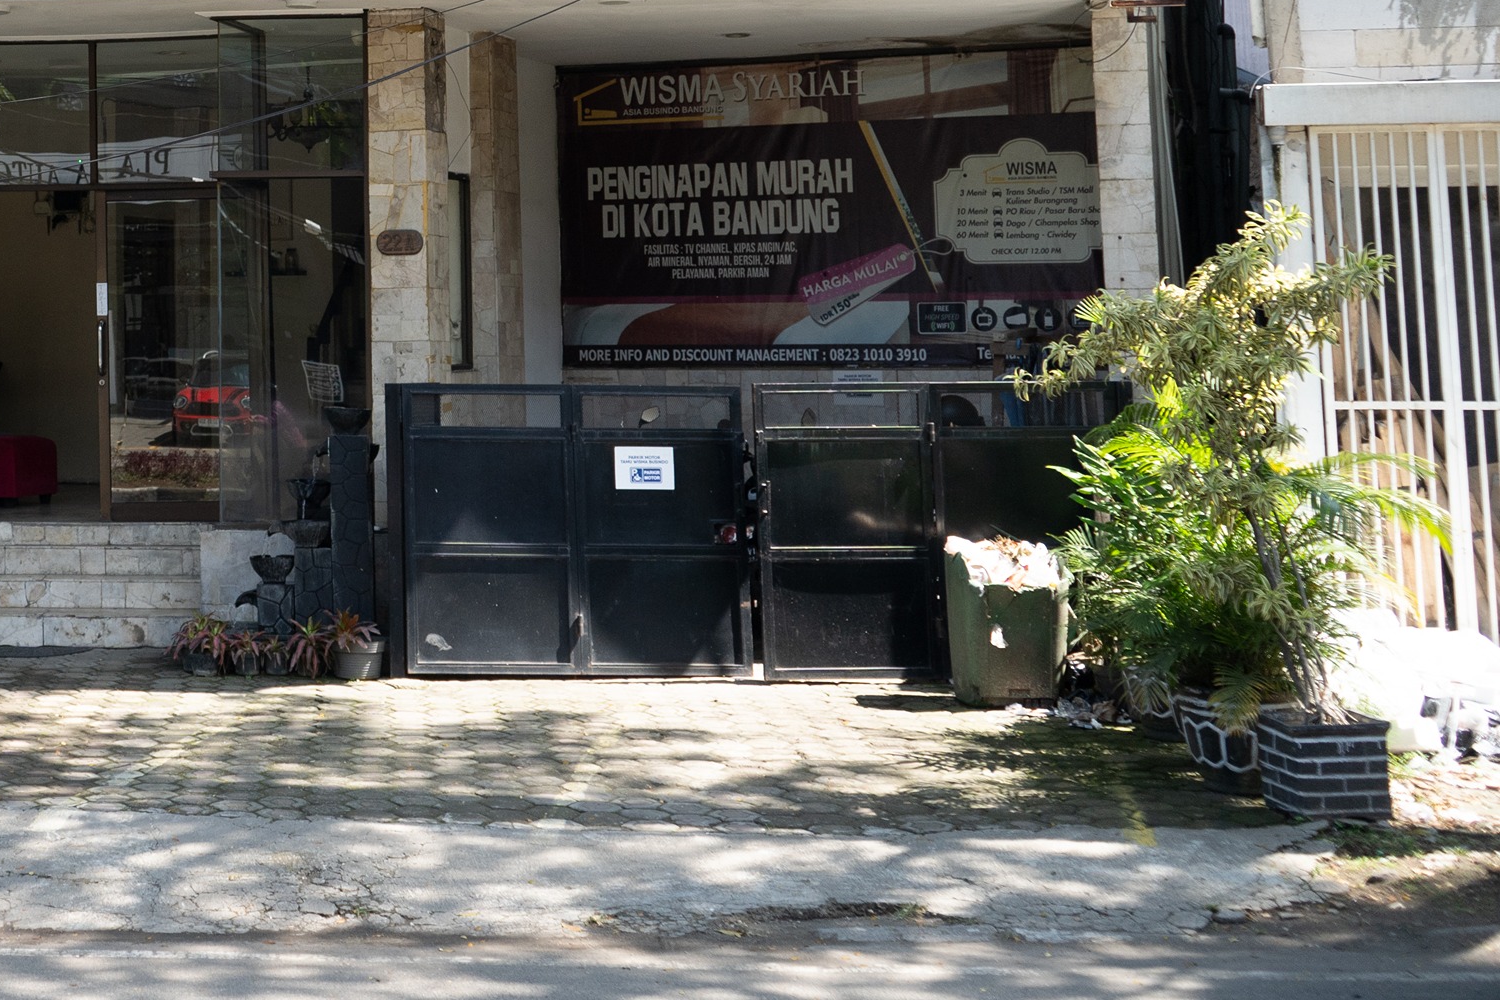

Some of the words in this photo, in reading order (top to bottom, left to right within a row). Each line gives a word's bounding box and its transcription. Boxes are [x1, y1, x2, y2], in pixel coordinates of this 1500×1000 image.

[620, 74, 724, 105] WISMA
[732, 70, 867, 102] SYARIAH
[622, 108, 644, 116] ASIA
[645, 106, 679, 116] BUSINDO
[682, 105, 724, 114] BANDUNG
[1006, 161, 1057, 175] WISMA
[587, 161, 749, 200] PENGINAPAN
[756, 158, 854, 196] MURAH
[960, 189, 965, 197] 3
[966, 189, 987, 197] Menit
[1027, 187, 1050, 195] Studio
[1059, 187, 1075, 195] TSM
[1077, 186, 1094, 194] Mall
[1006, 197, 1033, 205] Kuliner
[1034, 197, 1078, 206] Burangrang
[968, 207, 988, 215] Menit
[1019, 207, 1036, 215] Riau
[1045, 207, 1065, 215] Pasar
[1068, 206, 1086, 214] Baru
[602, 203, 626, 239] DI
[633, 202, 705, 238] KOTA
[713, 198, 840, 237] BANDUNG
[957, 219, 967, 227] 20
[968, 219, 989, 227] Menit
[1006, 219, 1026, 228] Dago
[1035, 218, 1078, 228] Cihampelas
[957, 231, 967, 239] 60
[968, 231, 989, 239] Menit
[1006, 231, 1040, 240] Lembang
[1047, 231, 1077, 240] Ciwidey
[684, 244, 695, 255] TV
[695, 243, 732, 255] CHANNEL,
[734, 243, 756, 254] KIPAS
[757, 242, 798, 254] ANGIN/AC,
[1031, 247, 1049, 255] 12.00
[648, 256, 661, 268] AIR
[662, 256, 697, 268] MINERAL,
[698, 255, 732, 267] NYAMAN,
[734, 255, 763, 267] BERSIH,
[765, 255, 774, 266] 24
[775, 254, 792, 266] JAM
[671, 268, 717, 280] PELAYANAN,
[718, 267, 746, 279] PARKIR
[747, 267, 770, 278] AMAN
[802, 274, 851, 298] HARGA
[853, 257, 899, 282] MULAI
[933, 304, 949, 312] FREE
[579, 349, 611, 361] MORE
[614, 349, 642, 361] INFO
[645, 349, 670, 361] AND
[672, 349, 734, 361] DISCOUNT
[736, 348, 819, 361] MANAGEMENT
[829, 348, 860, 361] 0823
[863, 348, 893, 361] 1010
[896, 348, 927, 361] 3910
